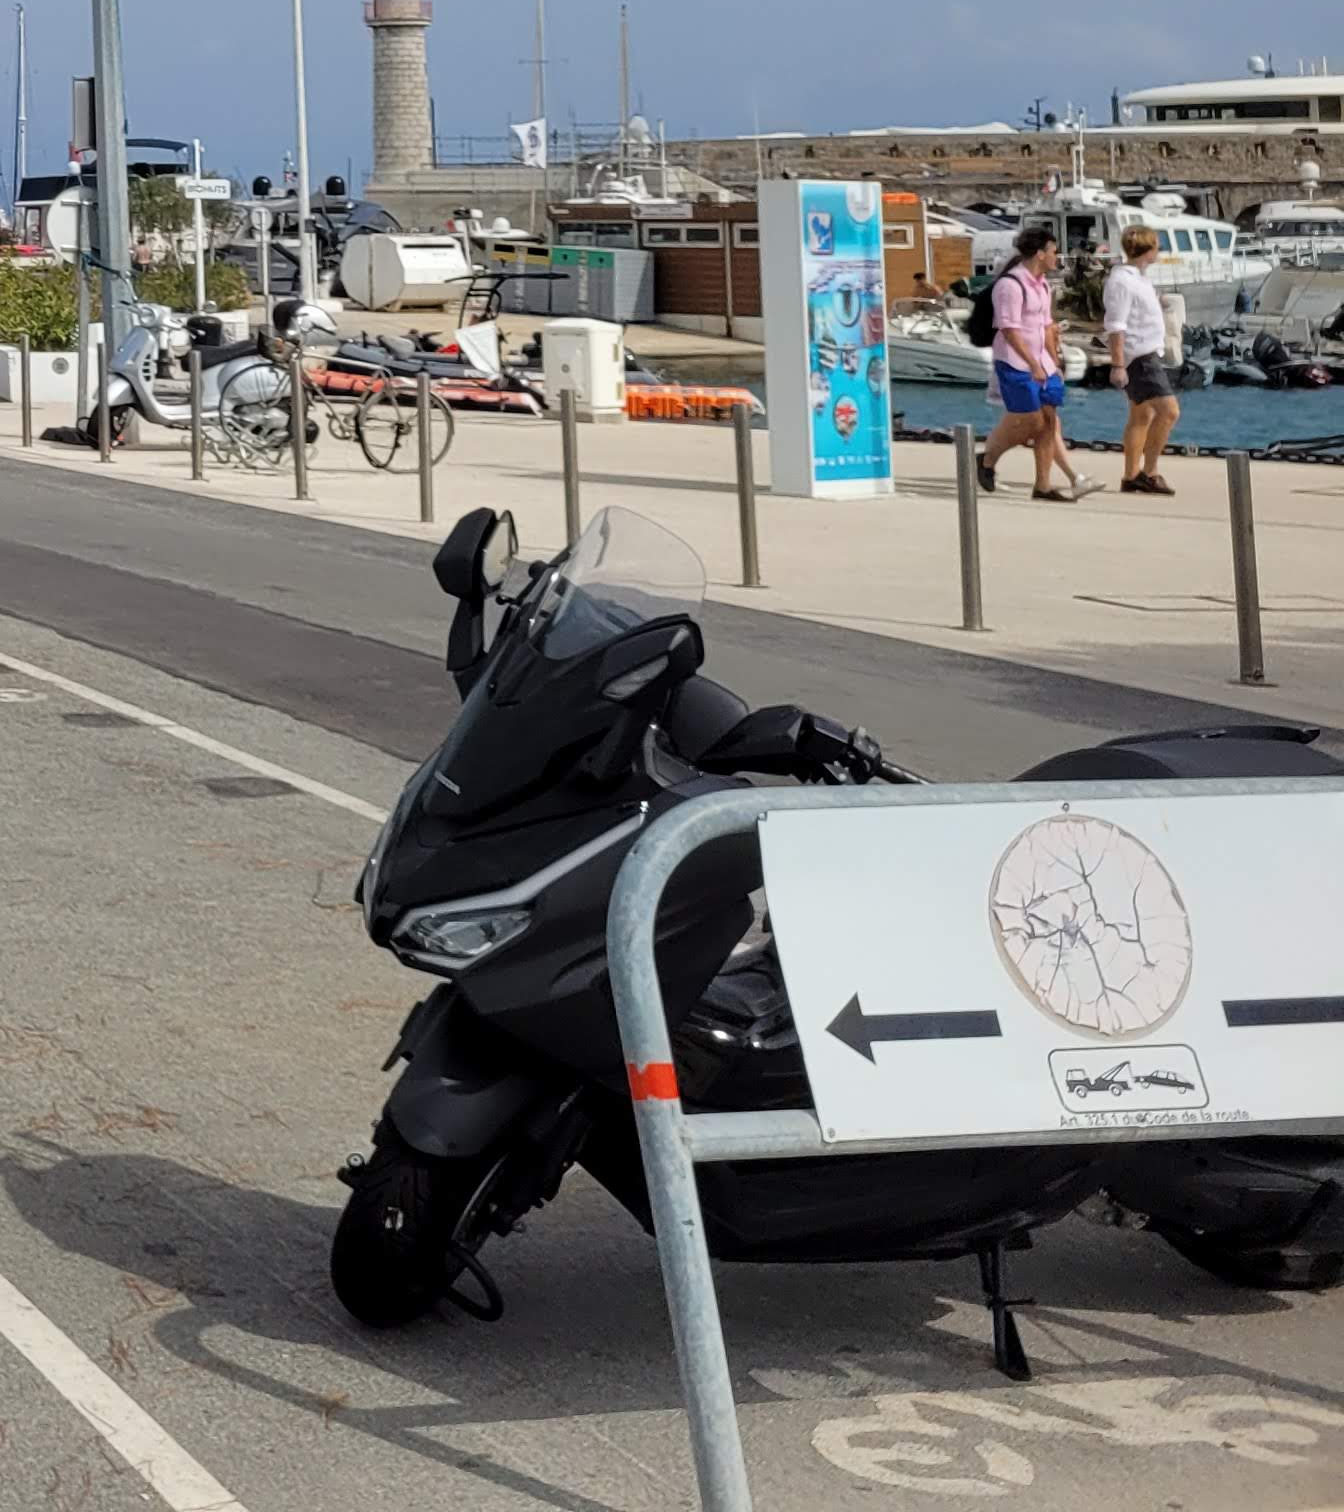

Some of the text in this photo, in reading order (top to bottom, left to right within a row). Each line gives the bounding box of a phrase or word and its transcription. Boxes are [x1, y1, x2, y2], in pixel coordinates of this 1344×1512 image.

[1142, 1110, 1177, 1125] Code
[1181, 1110, 1198, 1122] de
[1200, 1108, 1213, 1122] la
